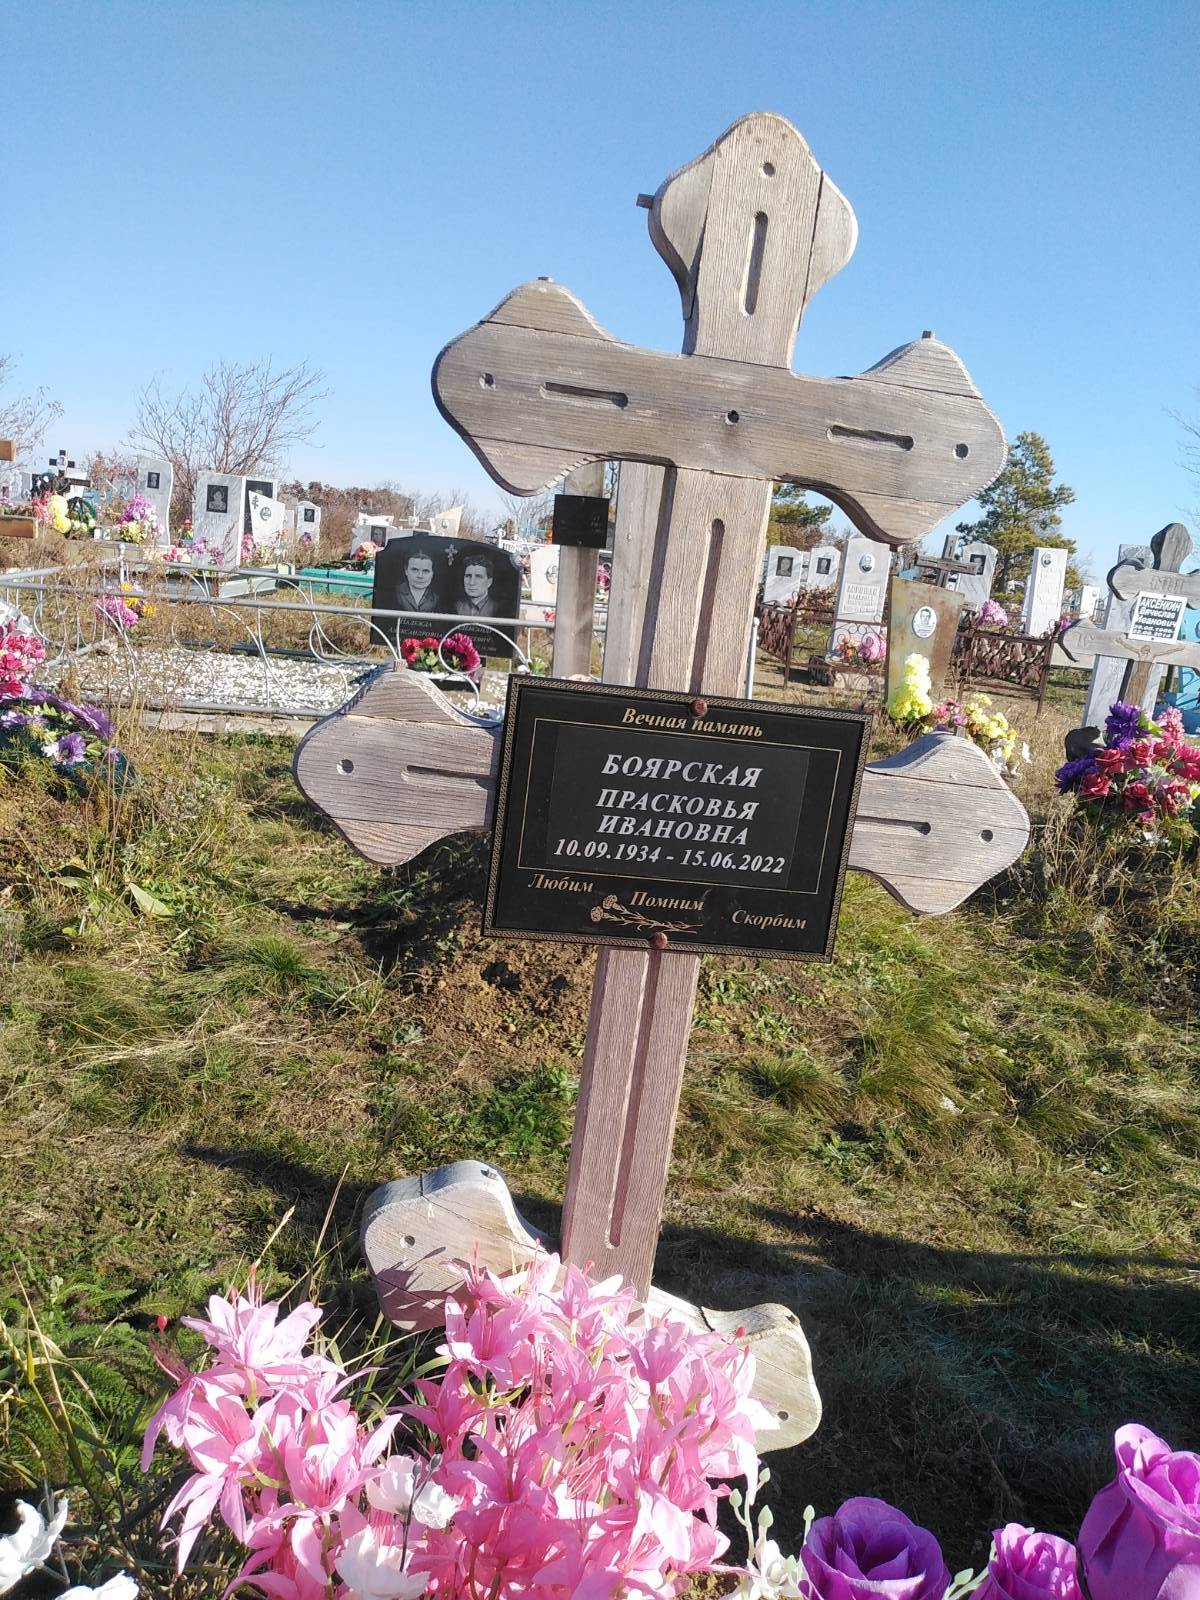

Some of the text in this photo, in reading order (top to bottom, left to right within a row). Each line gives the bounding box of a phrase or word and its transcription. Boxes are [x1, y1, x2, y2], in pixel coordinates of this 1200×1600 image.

[622, 708, 763, 738] Вечная память
[601, 753, 763, 788] БОЯРСКАЯ
[595, 789, 759, 821] ПРАСКОВЬЯ
[596, 815, 748, 846] ИВАНОВНА
[554, 838, 662, 864] 10.09.1934
[681, 848, 786, 874] 15.06.2022
[528, 873, 594, 893] Любим
[630, 891, 705, 911] Помним
[732, 909, 807, 930] Скорбим
